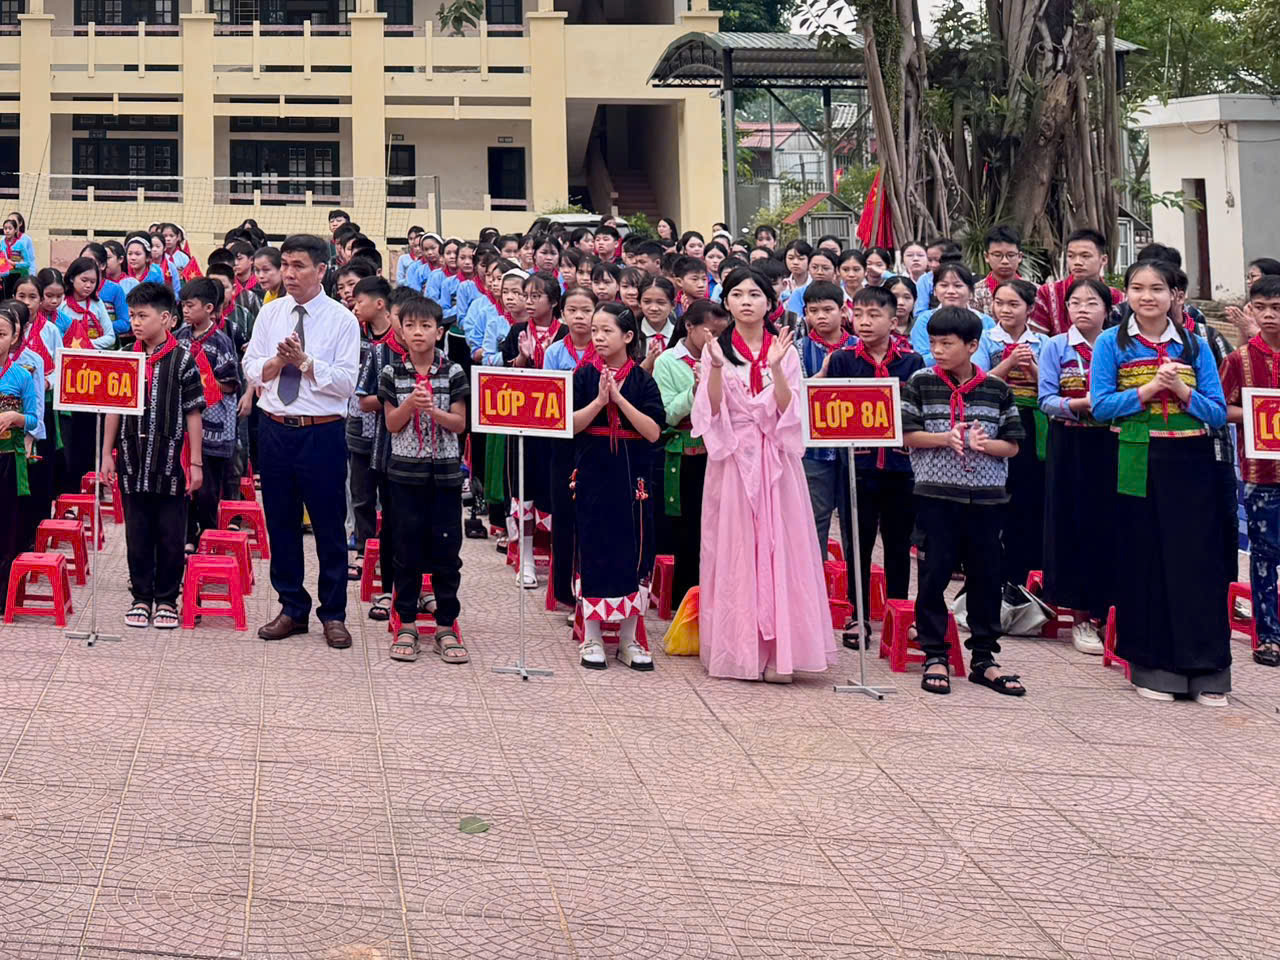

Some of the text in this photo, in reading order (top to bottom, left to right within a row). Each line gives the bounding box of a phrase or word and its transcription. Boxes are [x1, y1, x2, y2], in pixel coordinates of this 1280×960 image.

[65, 362, 132, 398] LỚP 6A
[484, 382, 561, 419] LỚP 7A
[814, 391, 889, 428] LỚP 8A
